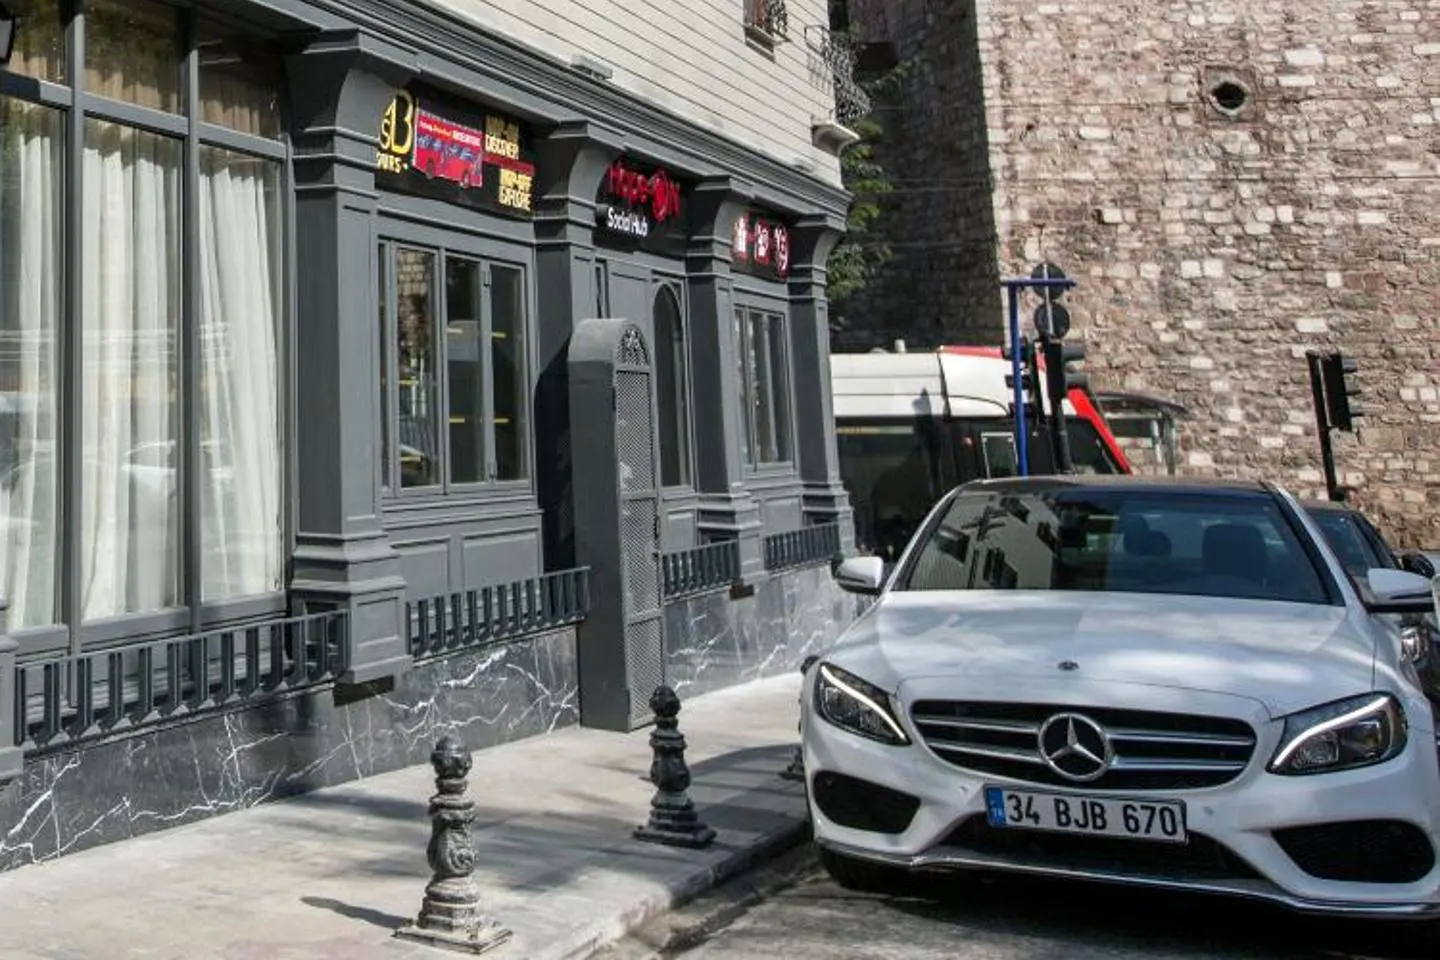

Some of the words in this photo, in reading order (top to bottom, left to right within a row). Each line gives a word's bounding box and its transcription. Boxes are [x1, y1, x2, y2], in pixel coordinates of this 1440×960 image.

[607, 206, 632, 232] Social
[631, 213, 648, 237] Hub
[1007, 793, 1041, 825] 34
[1053, 797, 1108, 831] BJB
[1122, 803, 1178, 836] 670
